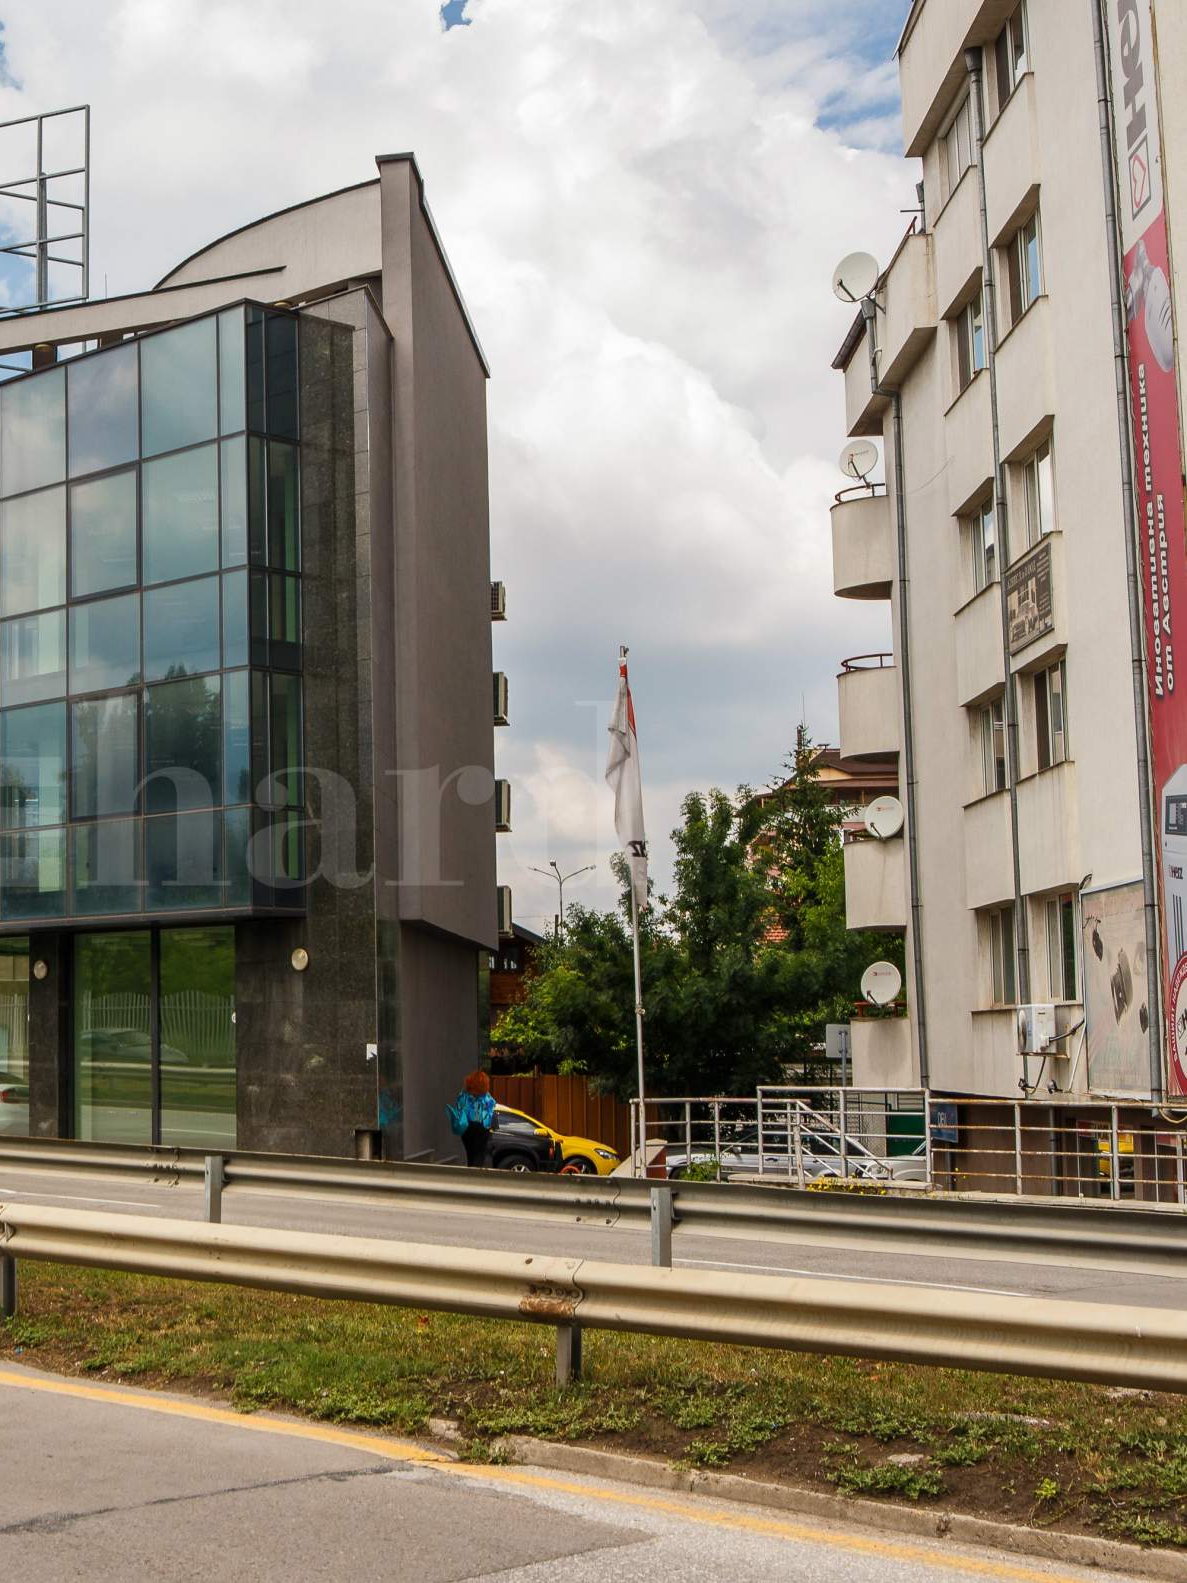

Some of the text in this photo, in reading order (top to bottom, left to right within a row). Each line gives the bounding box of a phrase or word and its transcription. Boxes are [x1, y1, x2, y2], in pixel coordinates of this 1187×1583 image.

[1138, 363, 1163, 696] Иновативна техника
[1156, 494, 1174, 691] от Австрия
